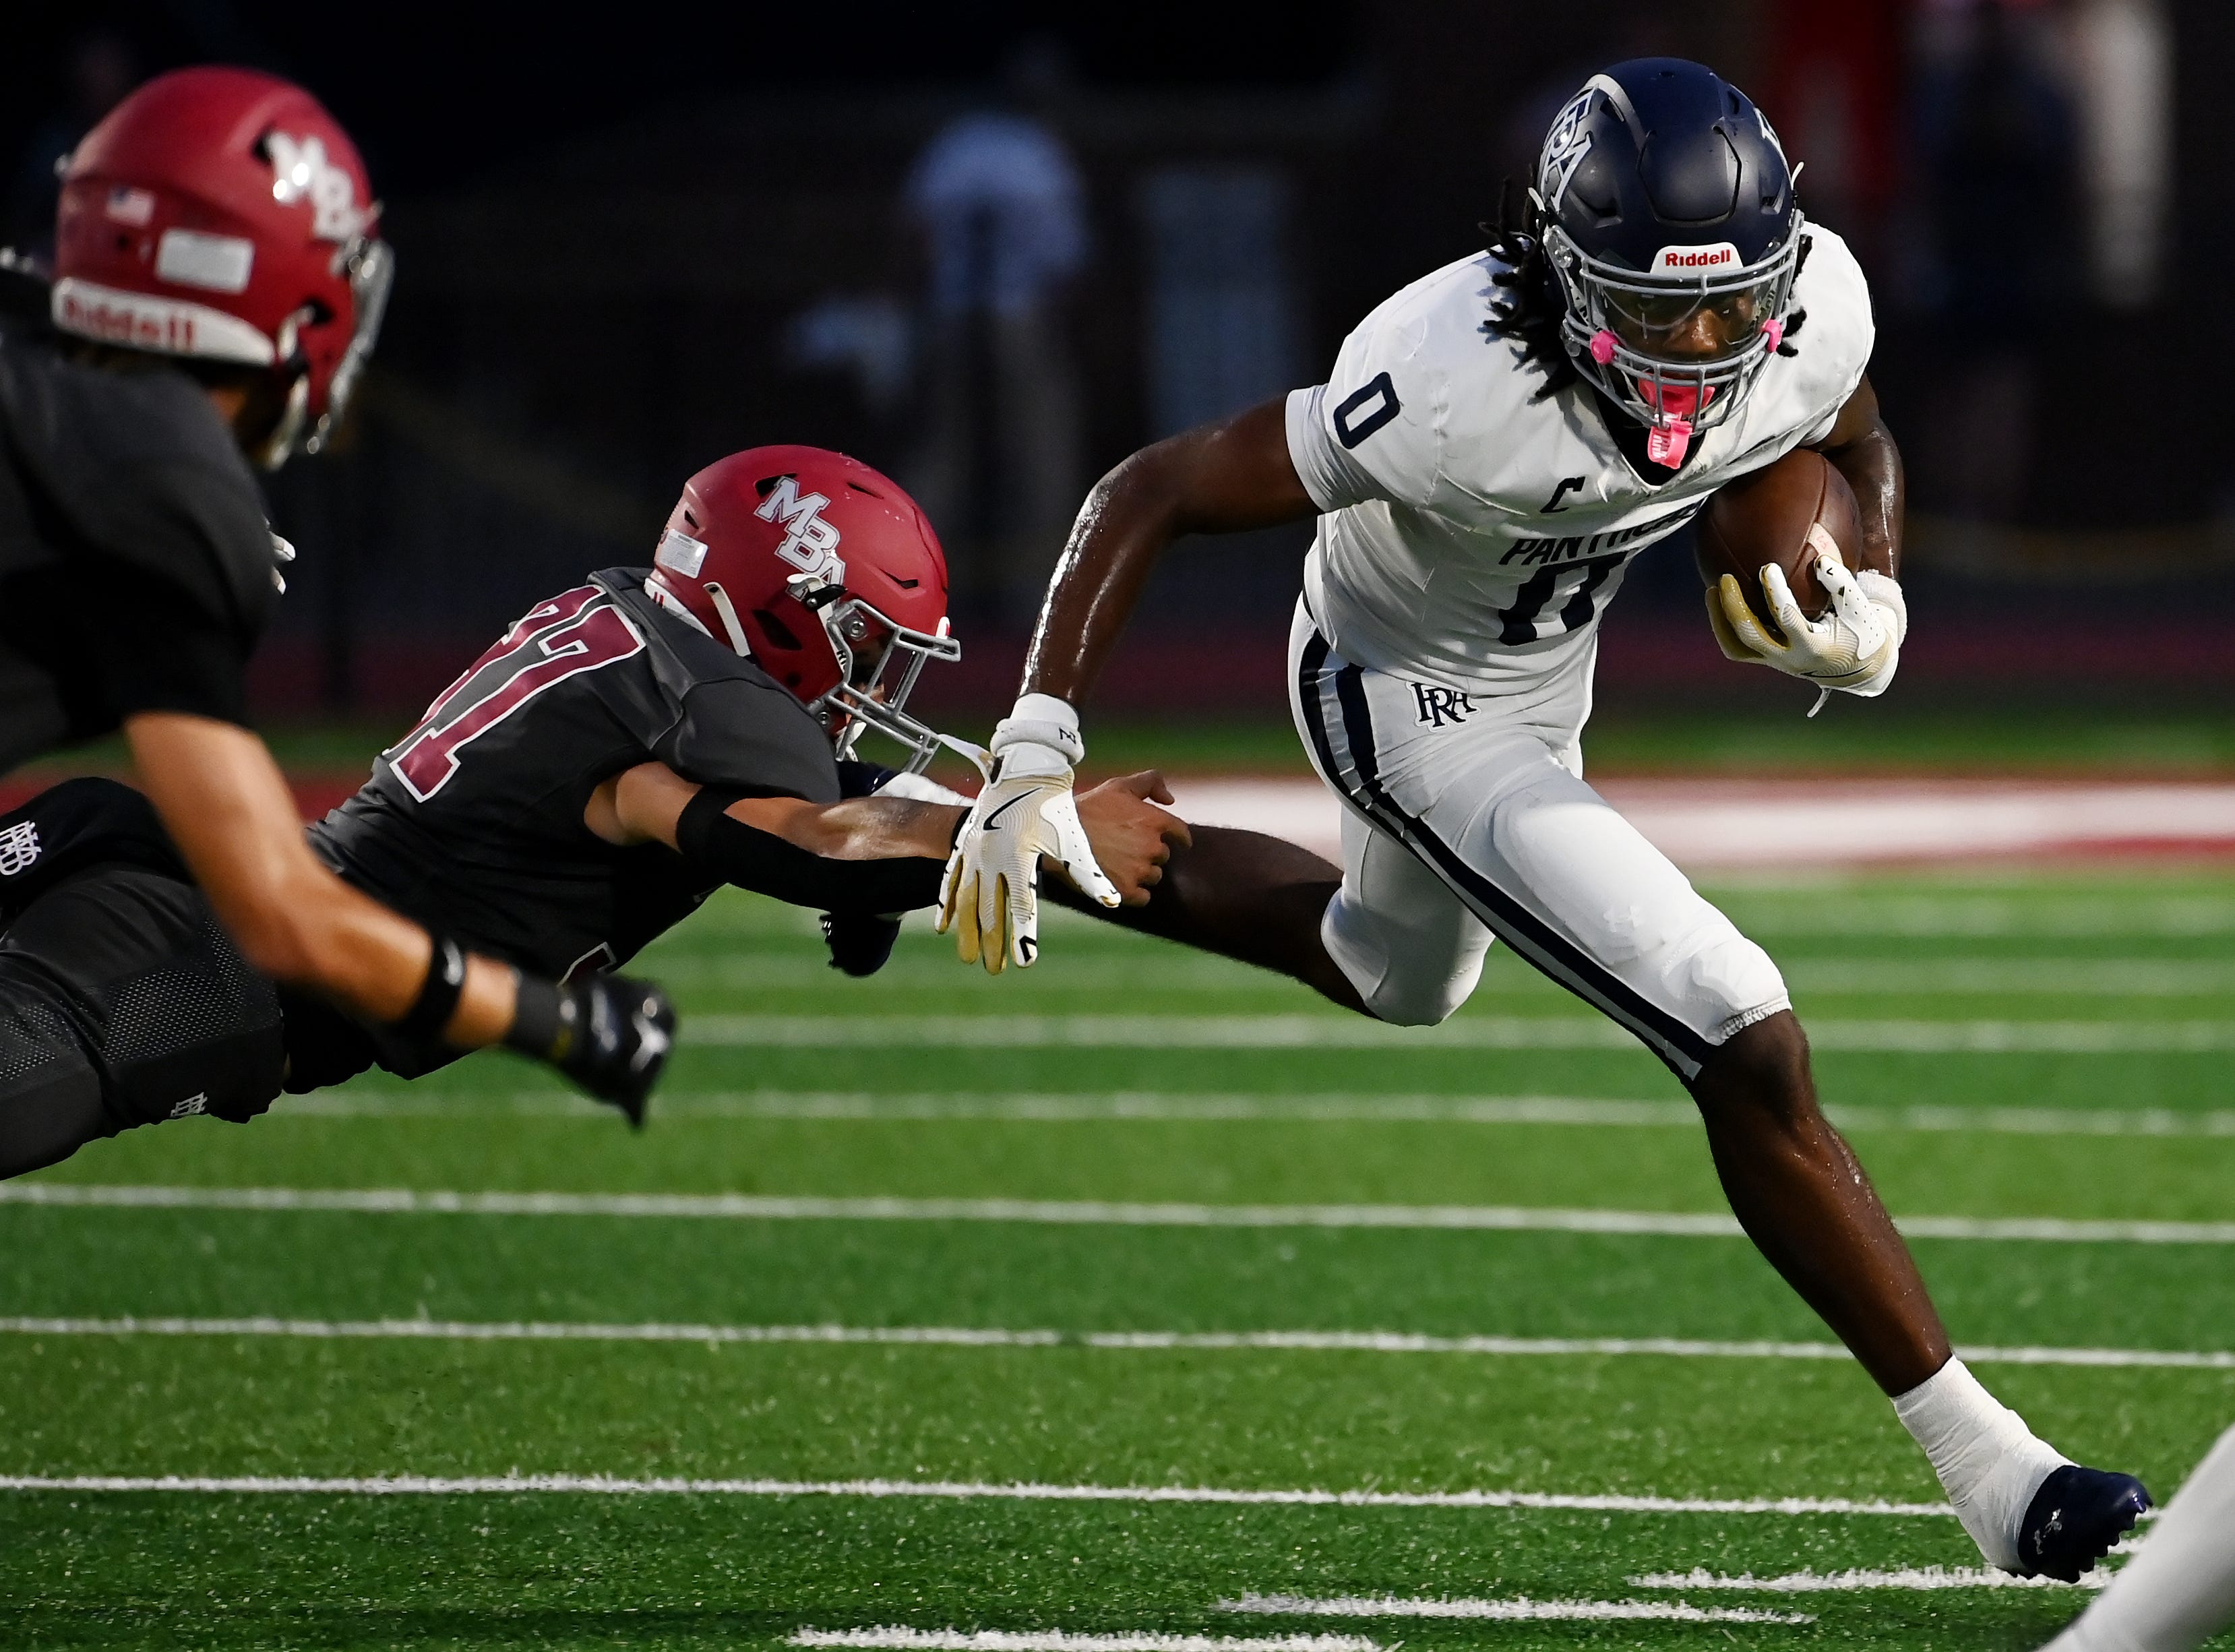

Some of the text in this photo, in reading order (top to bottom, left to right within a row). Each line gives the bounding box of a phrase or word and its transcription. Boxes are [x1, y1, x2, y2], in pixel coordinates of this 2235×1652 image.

[1665, 249, 1731, 266] Riddell
[1333, 371, 1402, 450] 0
[1539, 476, 1586, 514] C
